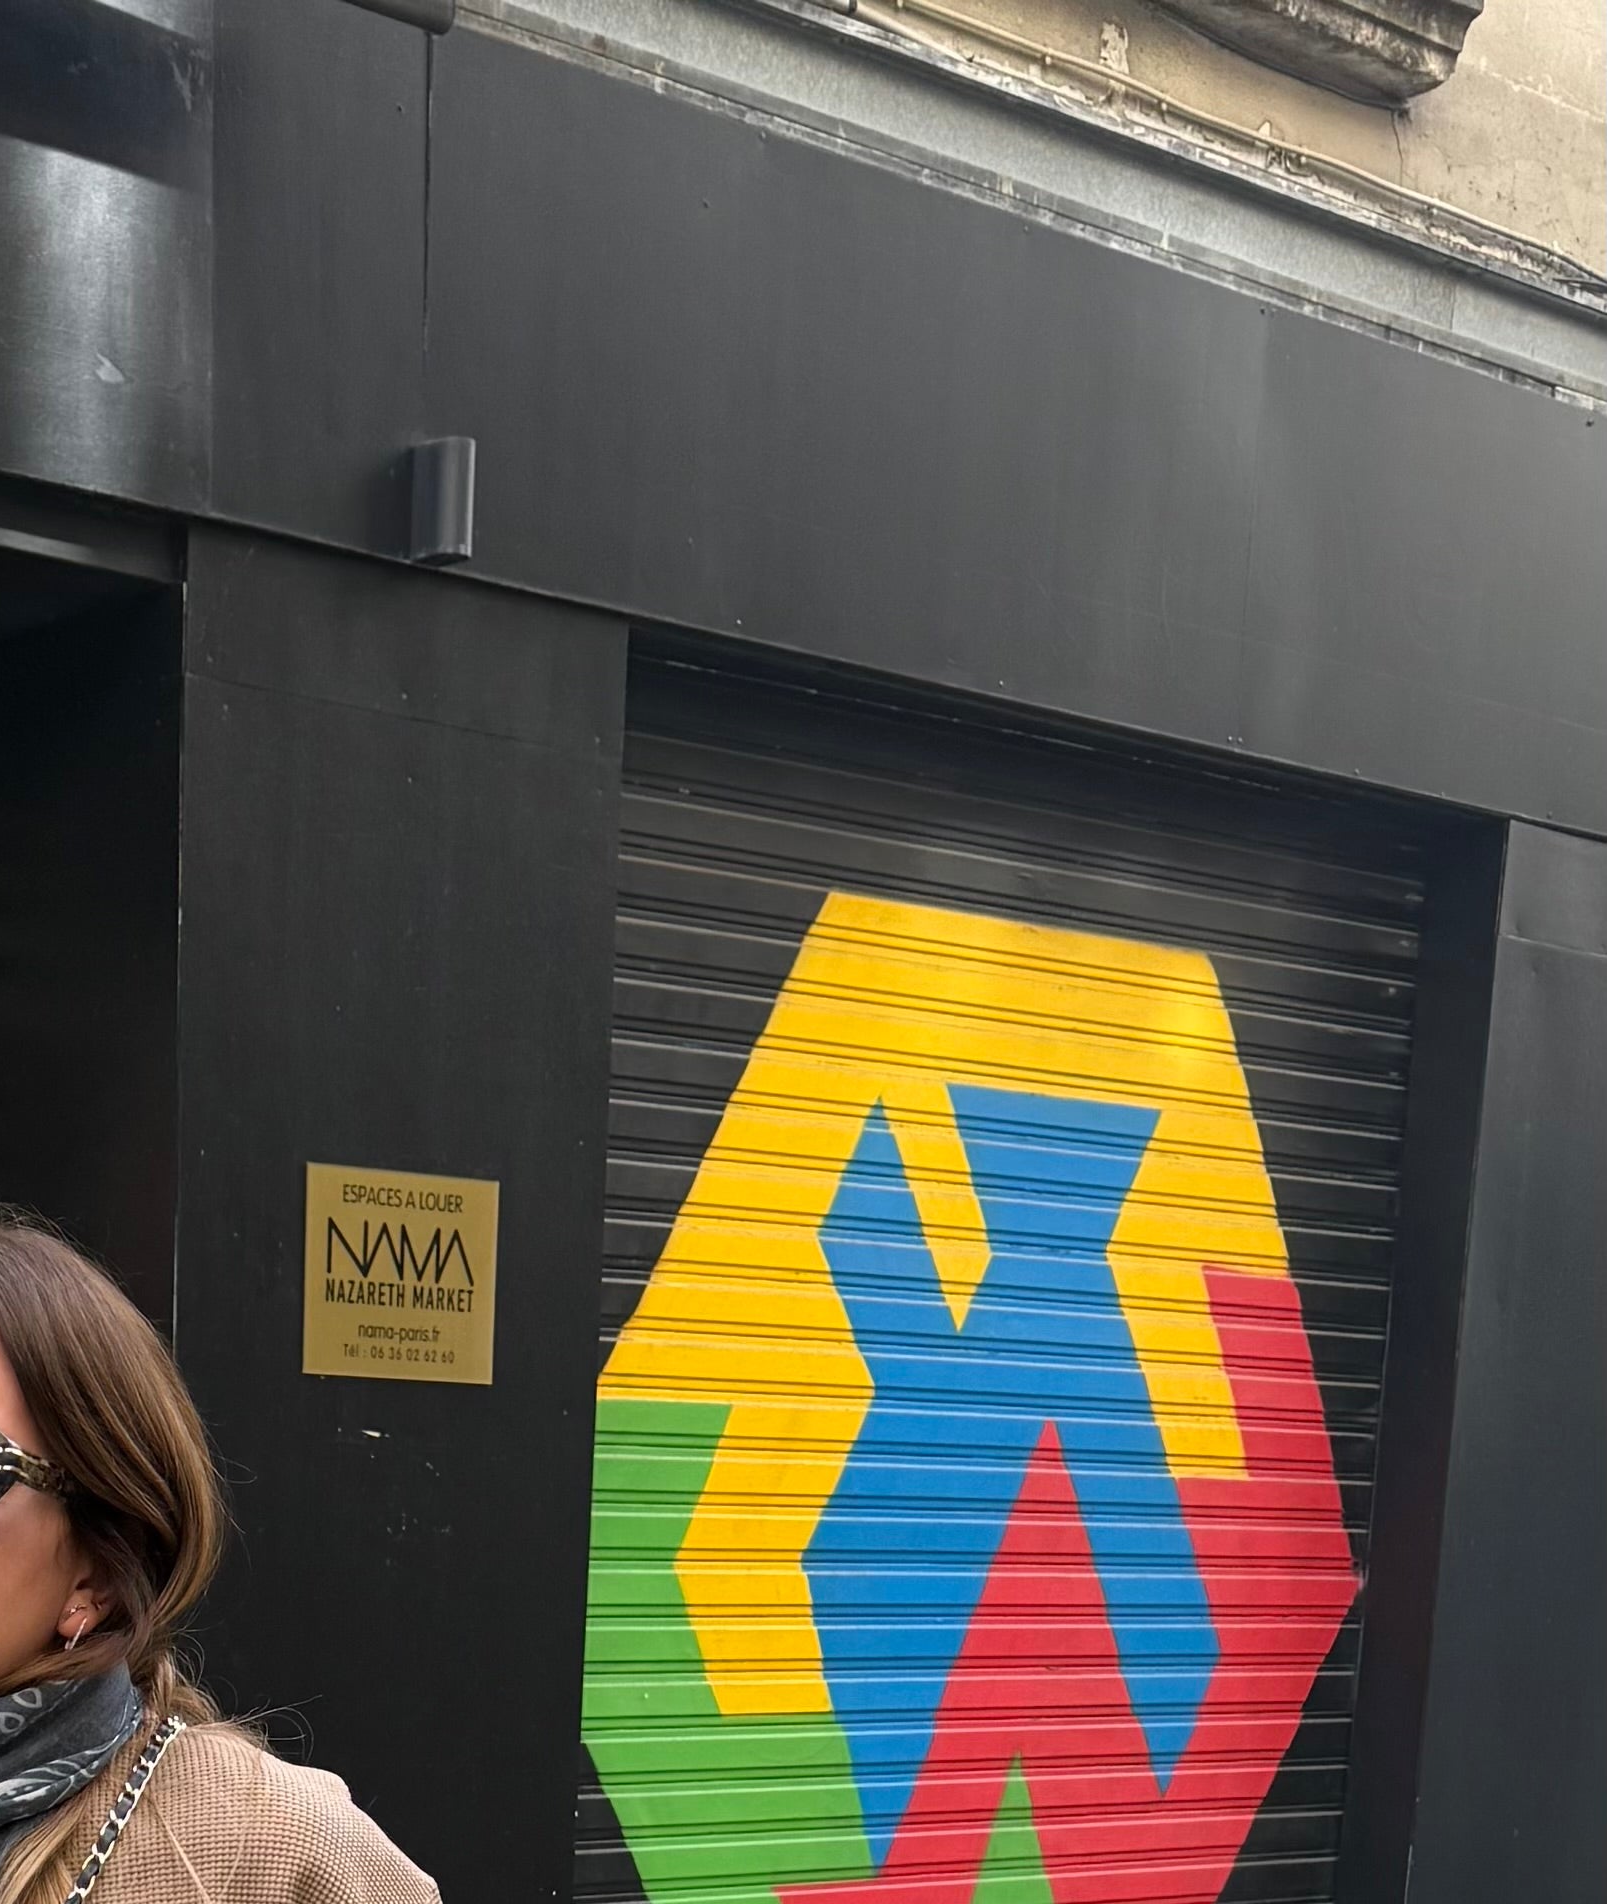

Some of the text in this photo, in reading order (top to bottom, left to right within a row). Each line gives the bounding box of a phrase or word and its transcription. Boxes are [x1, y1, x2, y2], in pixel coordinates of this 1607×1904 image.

[343, 1184, 463, 1213] ESPACES A LOUER
[327, 1216, 474, 1287] NAMA
[325, 1278, 474, 1312] NAZARETH MARKET
[358, 1323, 441, 1344] nama-paris.fr
[370, 1345, 385, 1359] 06
[406, 1348, 420, 1362] 02
